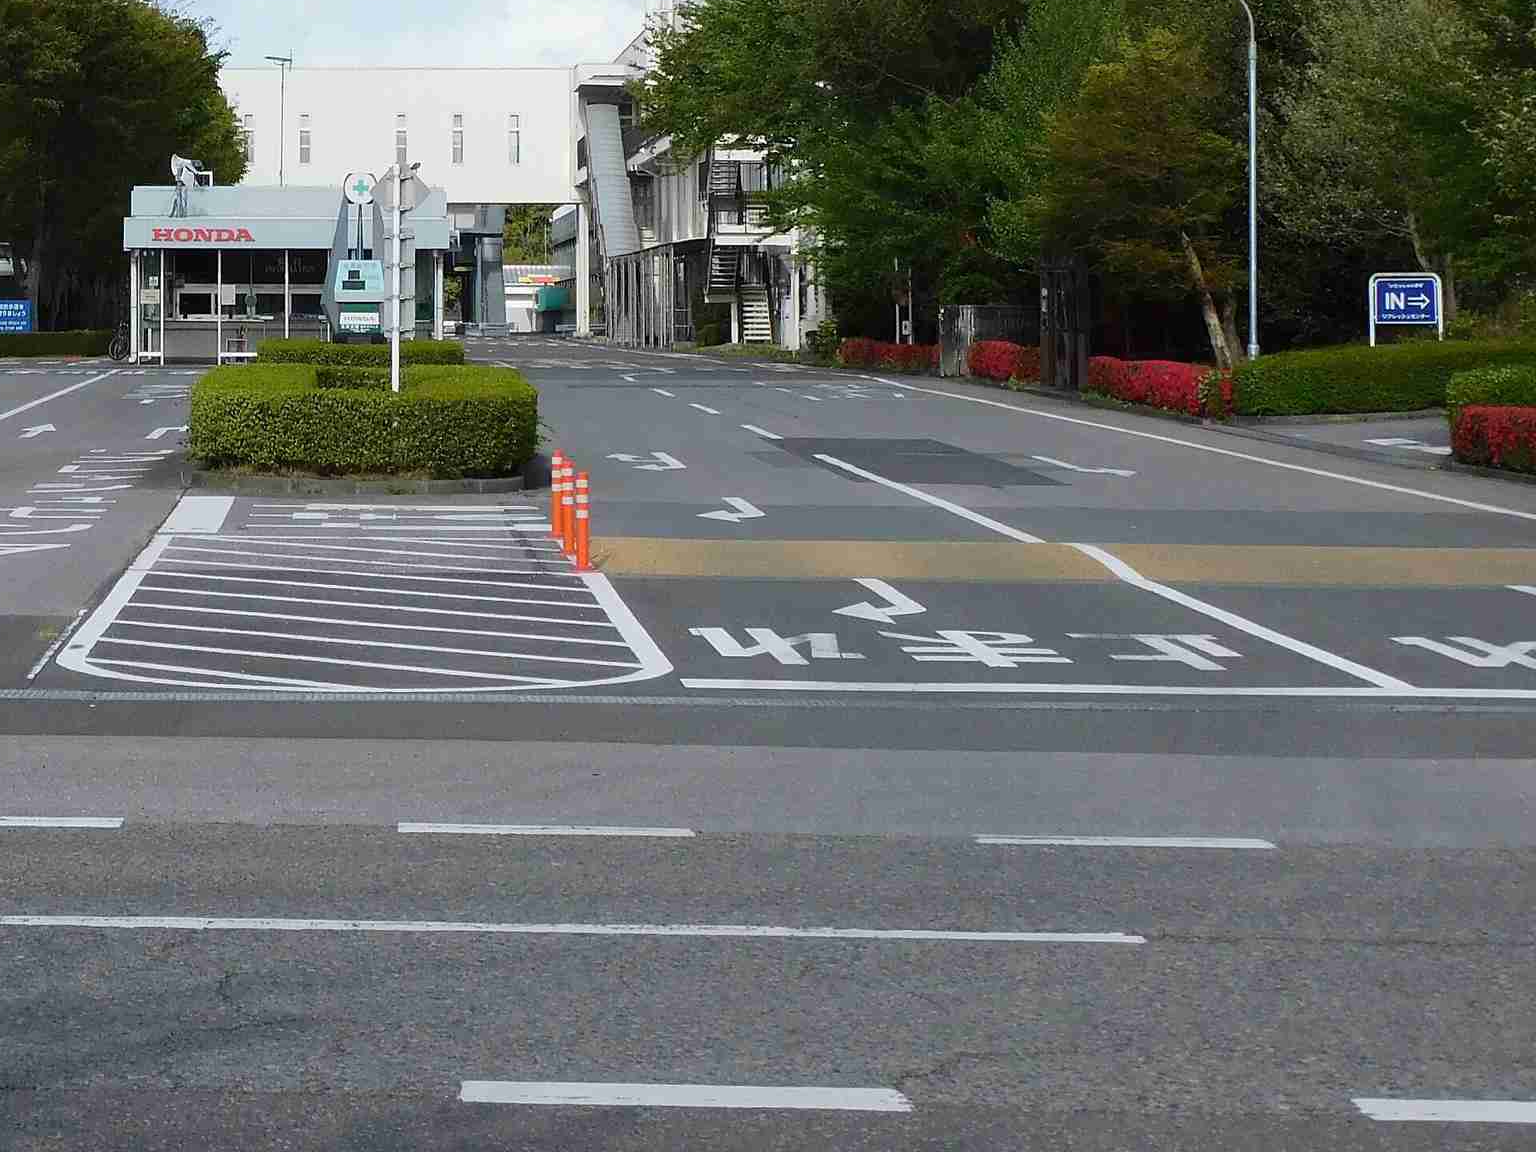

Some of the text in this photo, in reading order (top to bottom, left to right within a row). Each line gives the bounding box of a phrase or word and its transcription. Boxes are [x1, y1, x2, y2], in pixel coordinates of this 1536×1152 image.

[151, 227, 256, 242] HONDA
[1385, 292, 1405, 310] IN
[688, 626, 1242, 671] 止まれ
